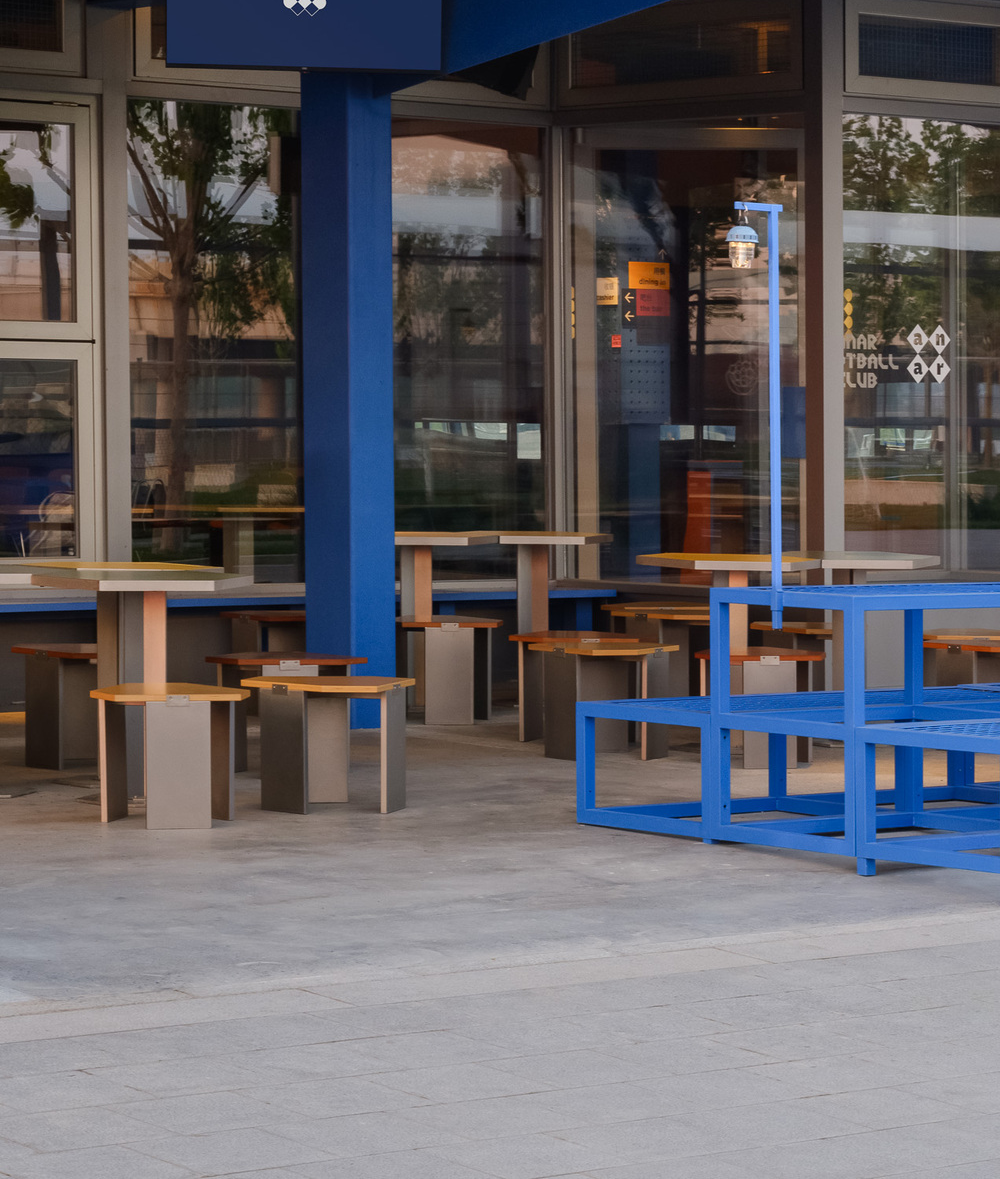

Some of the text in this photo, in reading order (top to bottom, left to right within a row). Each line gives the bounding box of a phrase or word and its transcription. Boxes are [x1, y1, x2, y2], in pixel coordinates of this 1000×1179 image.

[844, 333, 877, 350] NAR
[844, 353, 899, 370] TBALL
[844, 372, 878, 388] LUB
